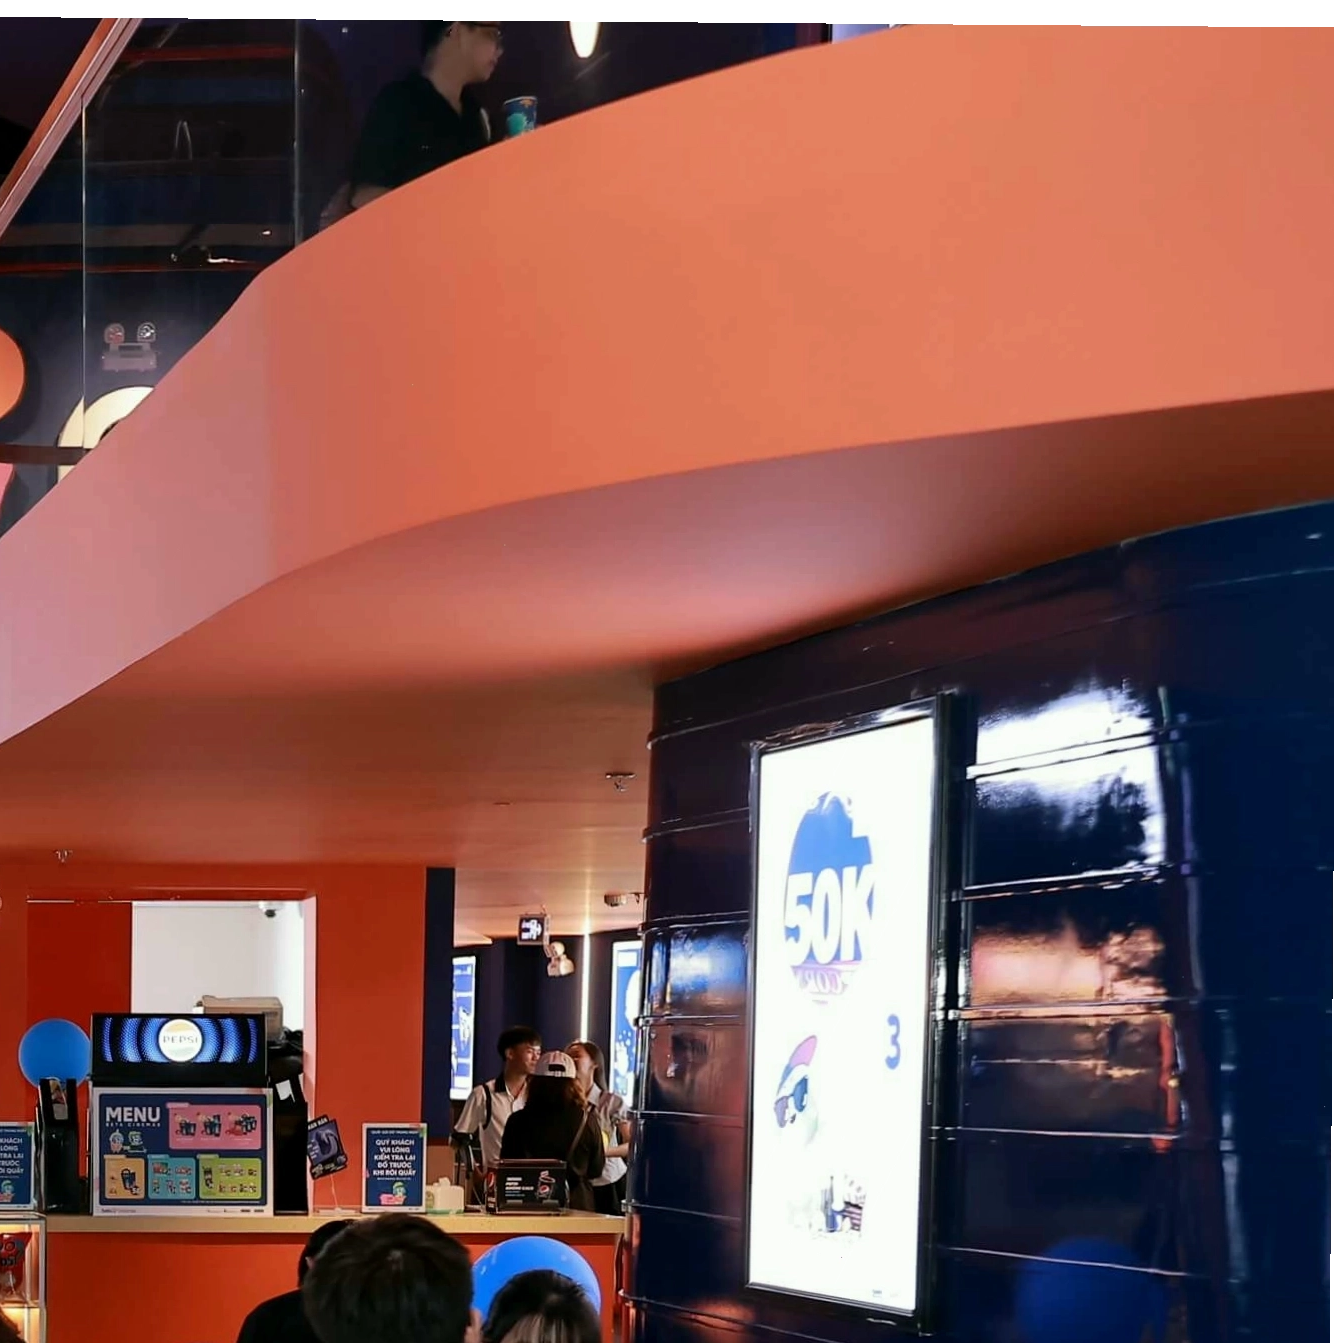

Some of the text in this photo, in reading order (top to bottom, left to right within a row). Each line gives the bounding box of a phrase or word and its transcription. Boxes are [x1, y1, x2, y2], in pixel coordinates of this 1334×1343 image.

[784, 863, 876, 966] 50K
[163, 1035, 199, 1045] PEPSI
[105, 1106, 161, 1122] MENU
